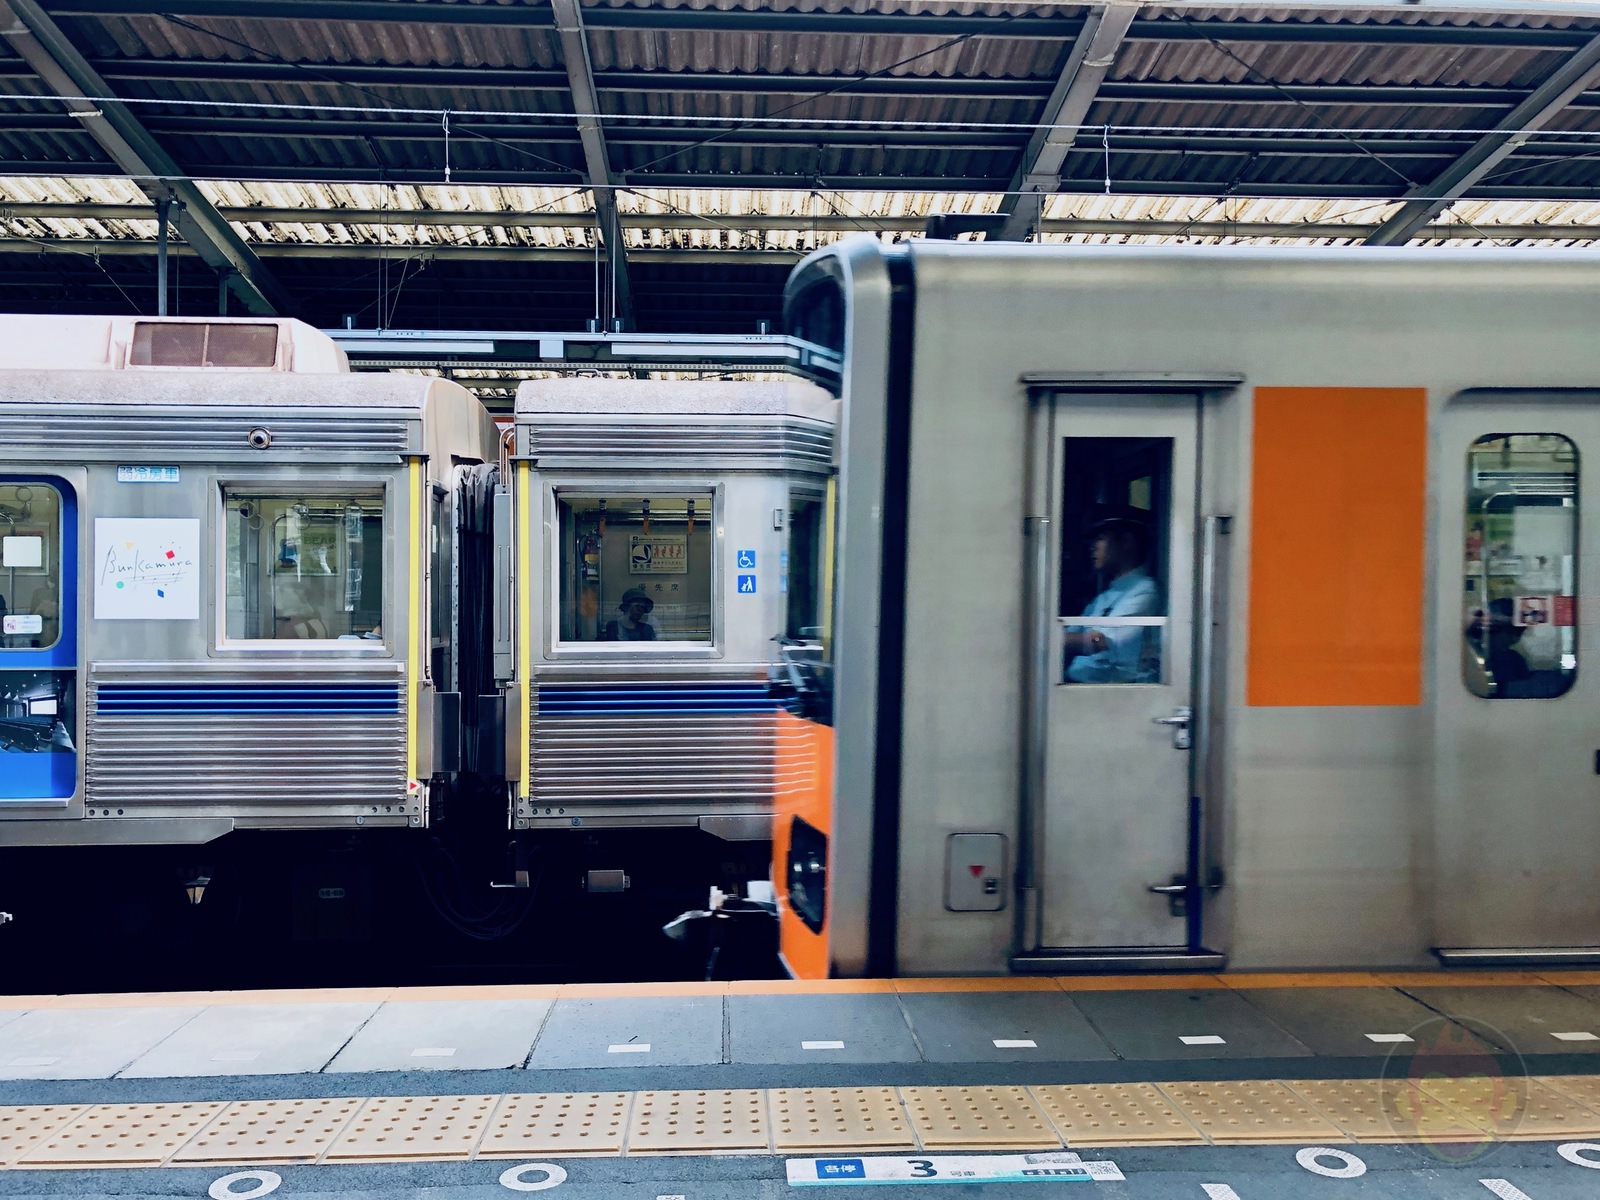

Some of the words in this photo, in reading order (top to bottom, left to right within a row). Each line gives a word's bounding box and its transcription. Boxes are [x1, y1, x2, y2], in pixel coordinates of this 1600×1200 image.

[118, 466, 178, 481] 弱冷房車
[823, 1164, 857, 1174] 各停
[906, 1159, 938, 1178] 3
